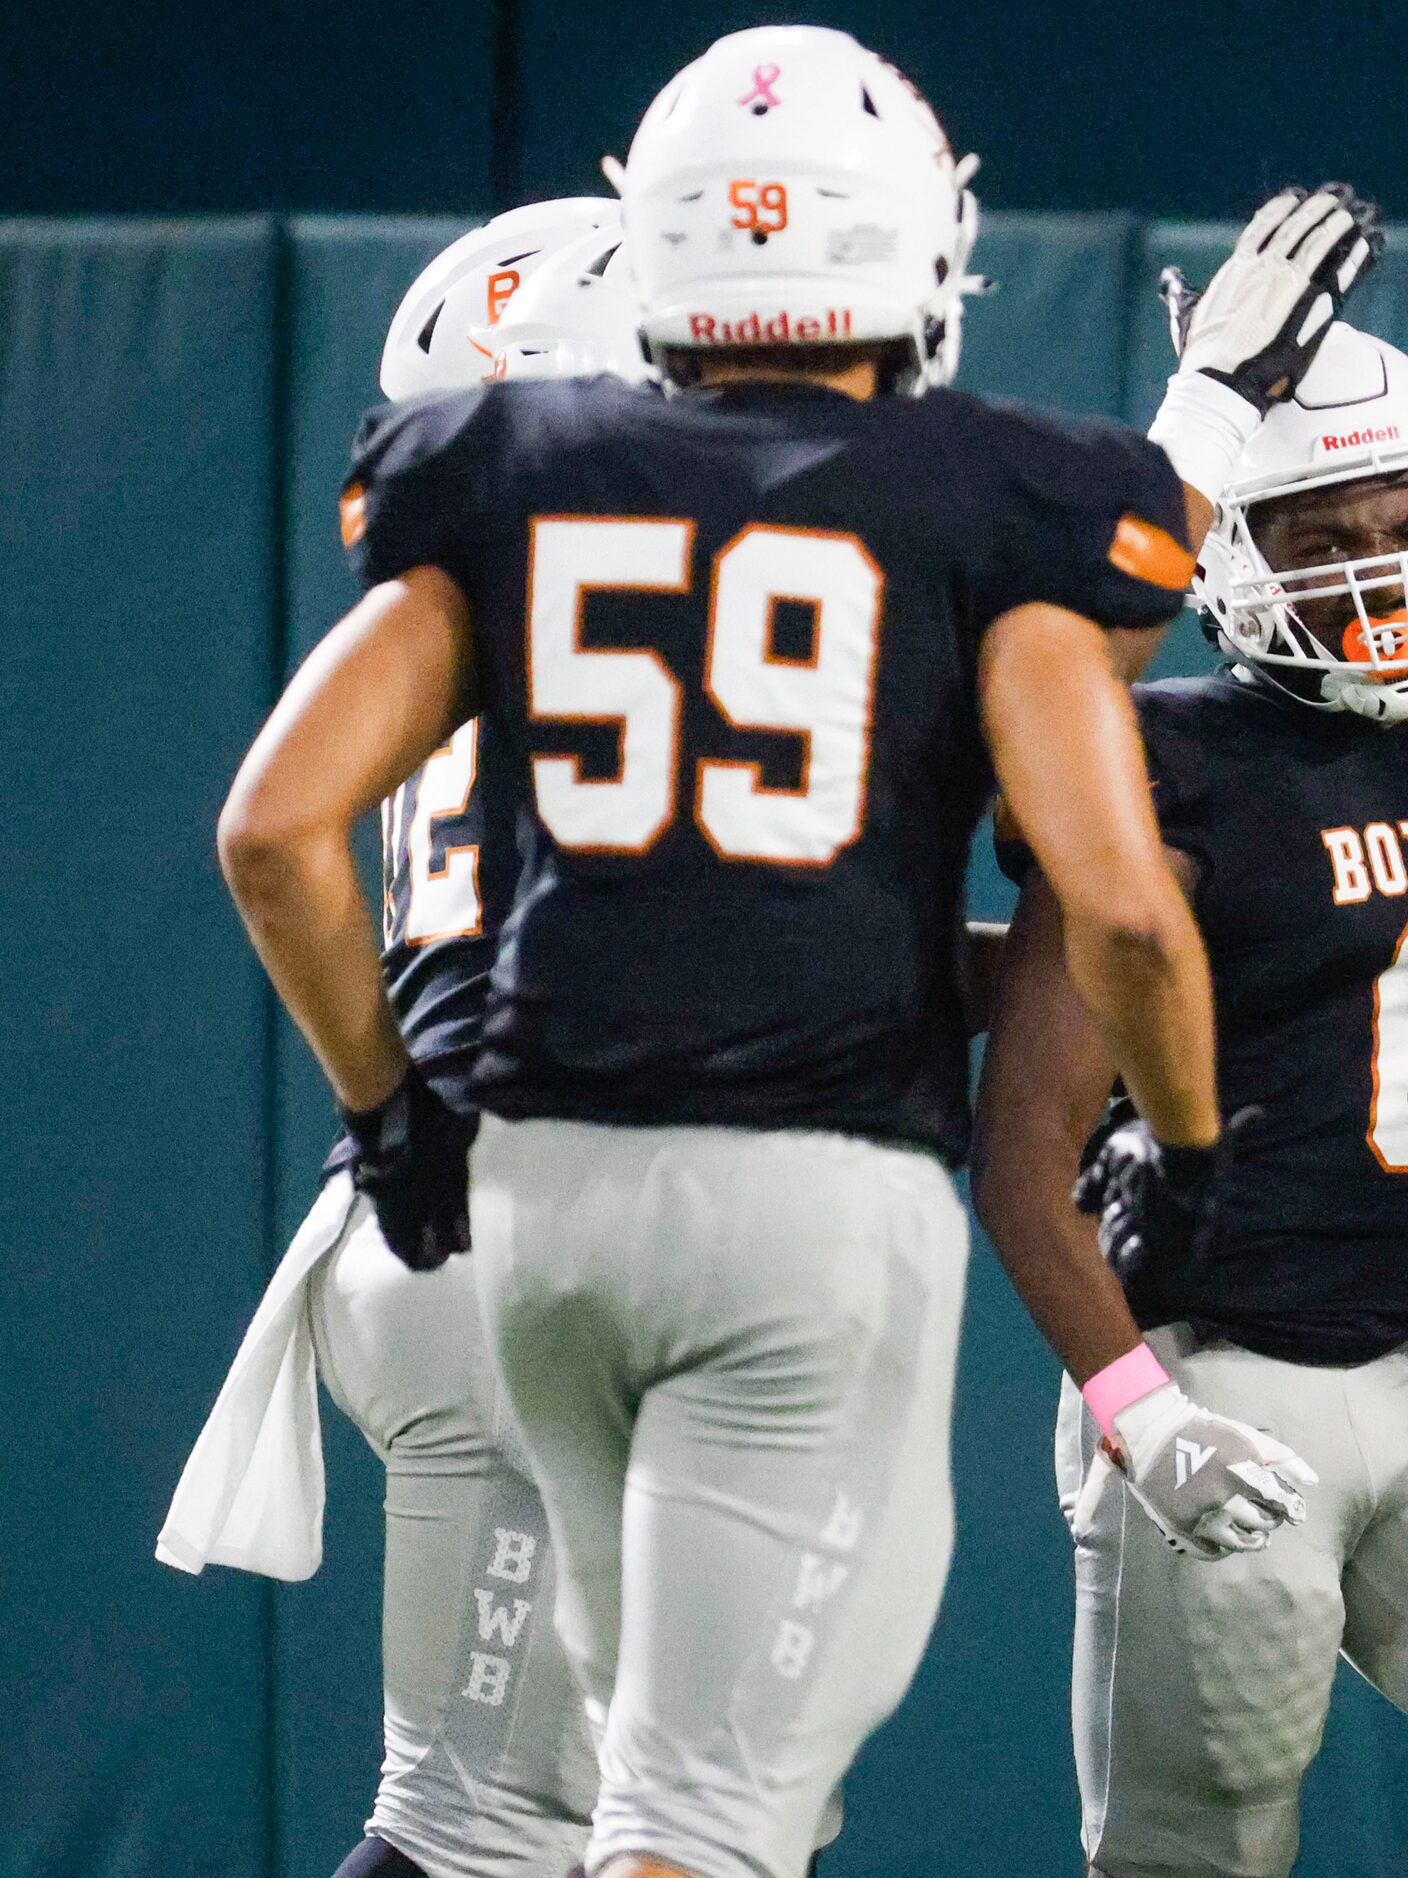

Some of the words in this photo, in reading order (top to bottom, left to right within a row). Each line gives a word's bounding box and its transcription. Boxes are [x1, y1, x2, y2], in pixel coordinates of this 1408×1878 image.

[729, 180, 788, 232] 59
[690, 309, 852, 343] Riddell
[1322, 425, 1400, 451] Riddell
[527, 514, 884, 868] 59
[461, 1527, 538, 1706] BWB
